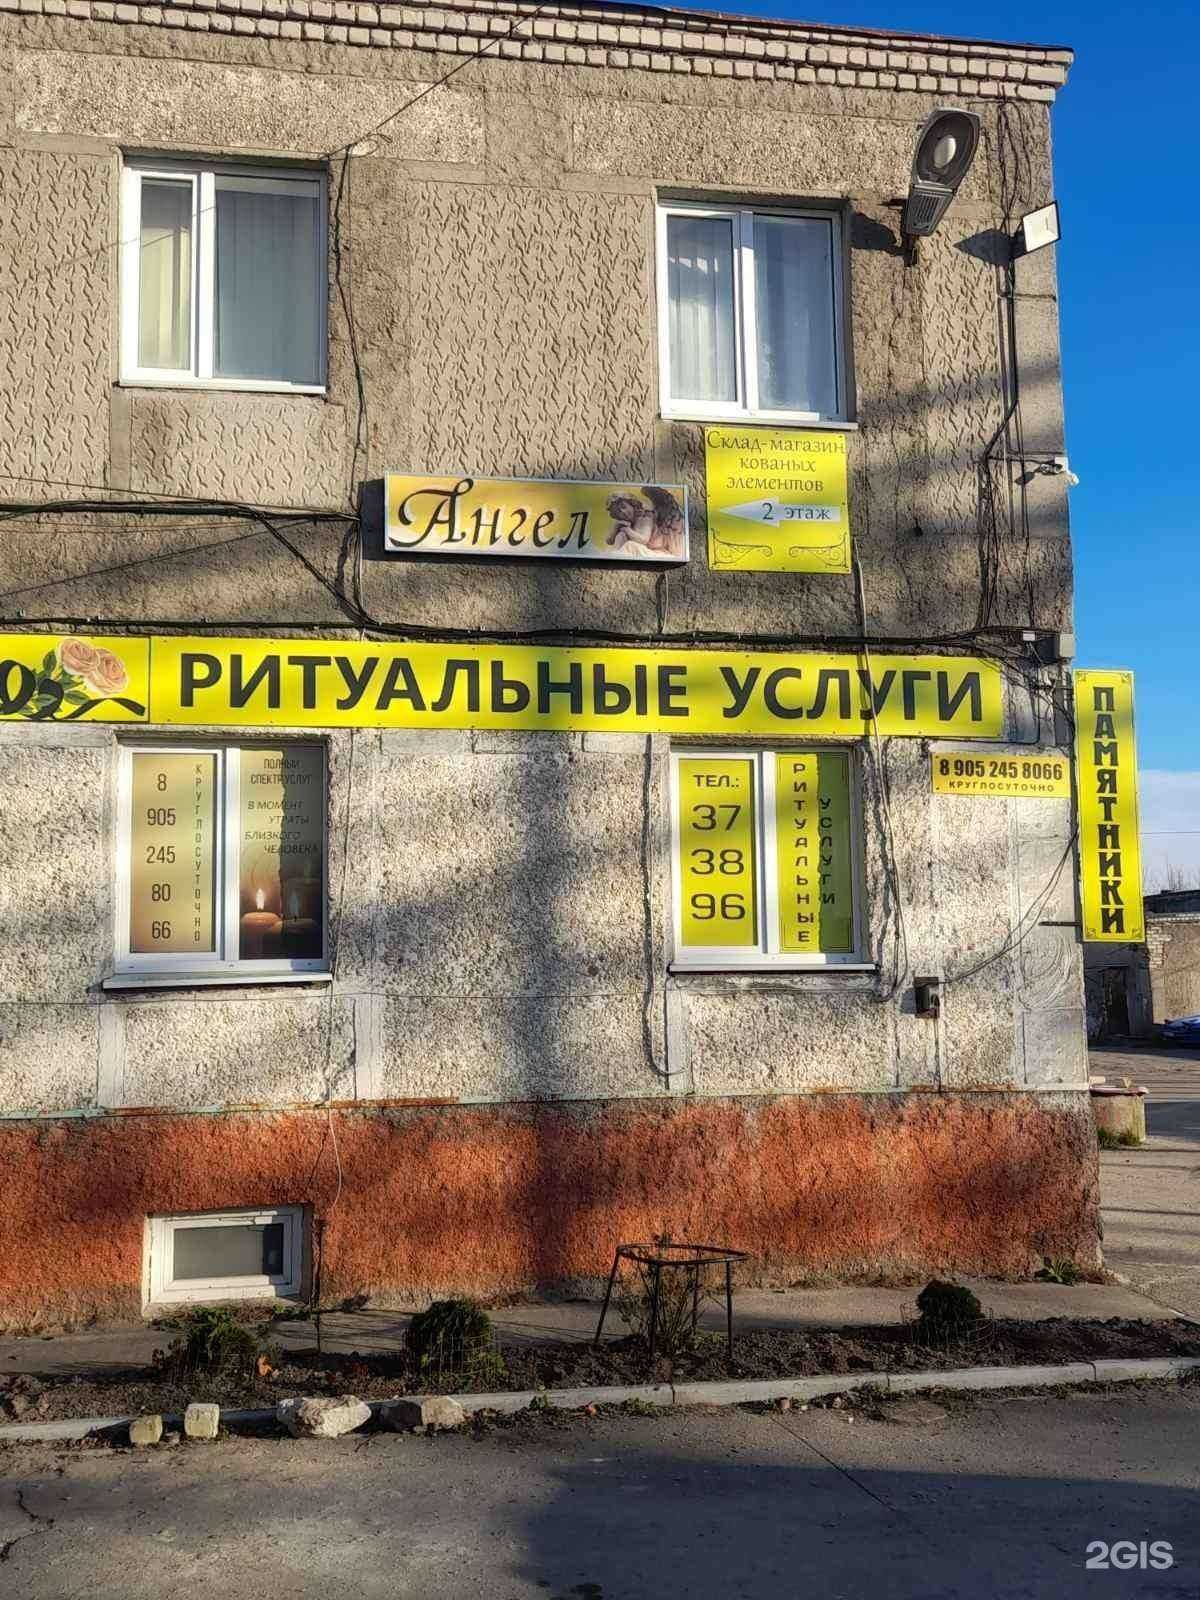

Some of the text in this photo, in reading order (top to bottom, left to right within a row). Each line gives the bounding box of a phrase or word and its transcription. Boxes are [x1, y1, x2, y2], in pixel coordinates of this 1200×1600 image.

[707, 431, 846, 454] Склад-магазин
[740, 457, 816, 473] кованых
[726, 476, 824, 492] элементов
[389, 478, 591, 548] Ангел
[762, 502, 831, 520] 2 этаж
[180, 652, 983, 722] РИТУАЛЬНЫЕ УСЛУГИ
[939, 758, 1063, 780] 8 905 245 8066
[157, 773, 167, 791] 8
[693, 775, 740, 788] ТЕЛ.:
[949, 780, 1055, 792] КРУГЛОСУТОЧНО
[247, 801, 255, 810] В
[1093, 686, 1124, 934] ПАМЯТНИКИ
[146, 808, 176, 826] 905
[692, 804, 742, 831] 37
[146, 846, 176, 864] 245
[193, 765, 203, 941] КРУГЛОСУТОЧНО
[793, 763, 814, 942] РИТУАЛЬНЫЕ
[819, 798, 836, 905] УСЛУГИ
[690, 849, 744, 876] 38
[151, 884, 171, 902] 80
[690, 893, 746, 920] 96
[151, 921, 171, 939] 66
